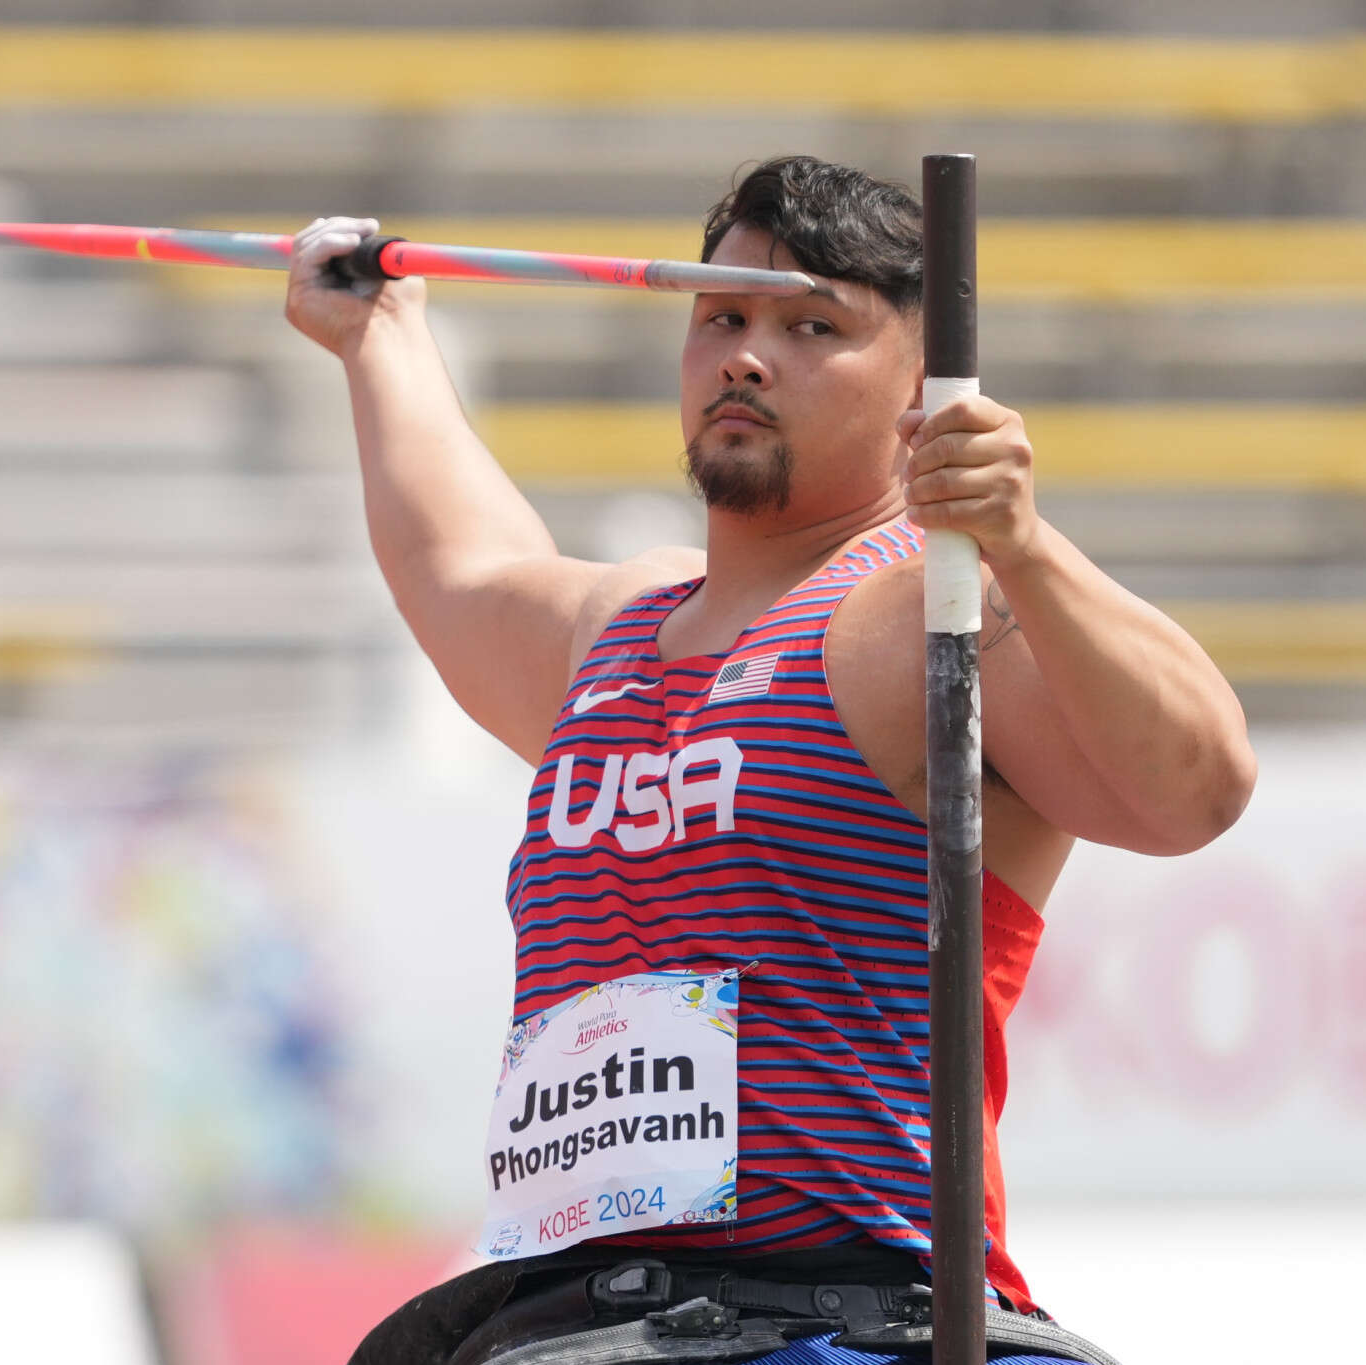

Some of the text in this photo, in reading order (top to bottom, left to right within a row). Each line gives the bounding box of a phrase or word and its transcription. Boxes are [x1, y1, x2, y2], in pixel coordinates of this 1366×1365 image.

[547, 736, 744, 852] USA
[575, 1019, 628, 1049] Athletics
[577, 1009, 617, 1031] World Para
[509, 1047, 695, 1134] Justin
[490, 1102, 725, 1192] Phongsavanh
[538, 1199, 591, 1244] KOBE
[597, 1186, 666, 1222] 2024
